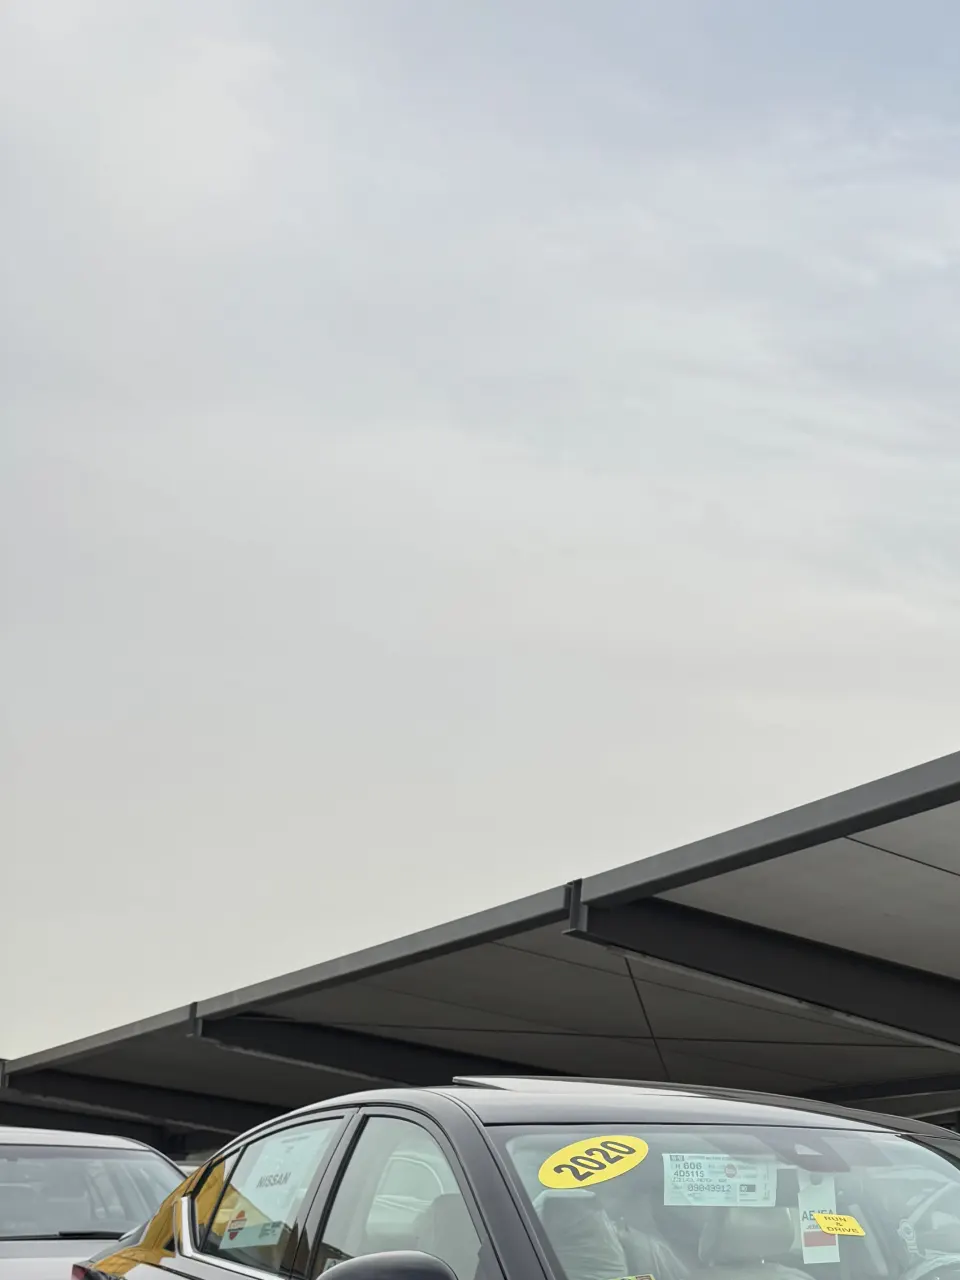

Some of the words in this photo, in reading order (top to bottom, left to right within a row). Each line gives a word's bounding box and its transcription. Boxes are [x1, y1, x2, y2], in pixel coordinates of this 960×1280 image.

[553, 1140, 636, 1181] 2020
[256, 1172, 291, 1189] NISSAN
[823, 1215, 847, 1223] RUN
[826, 1226, 860, 1234] DRIVE
